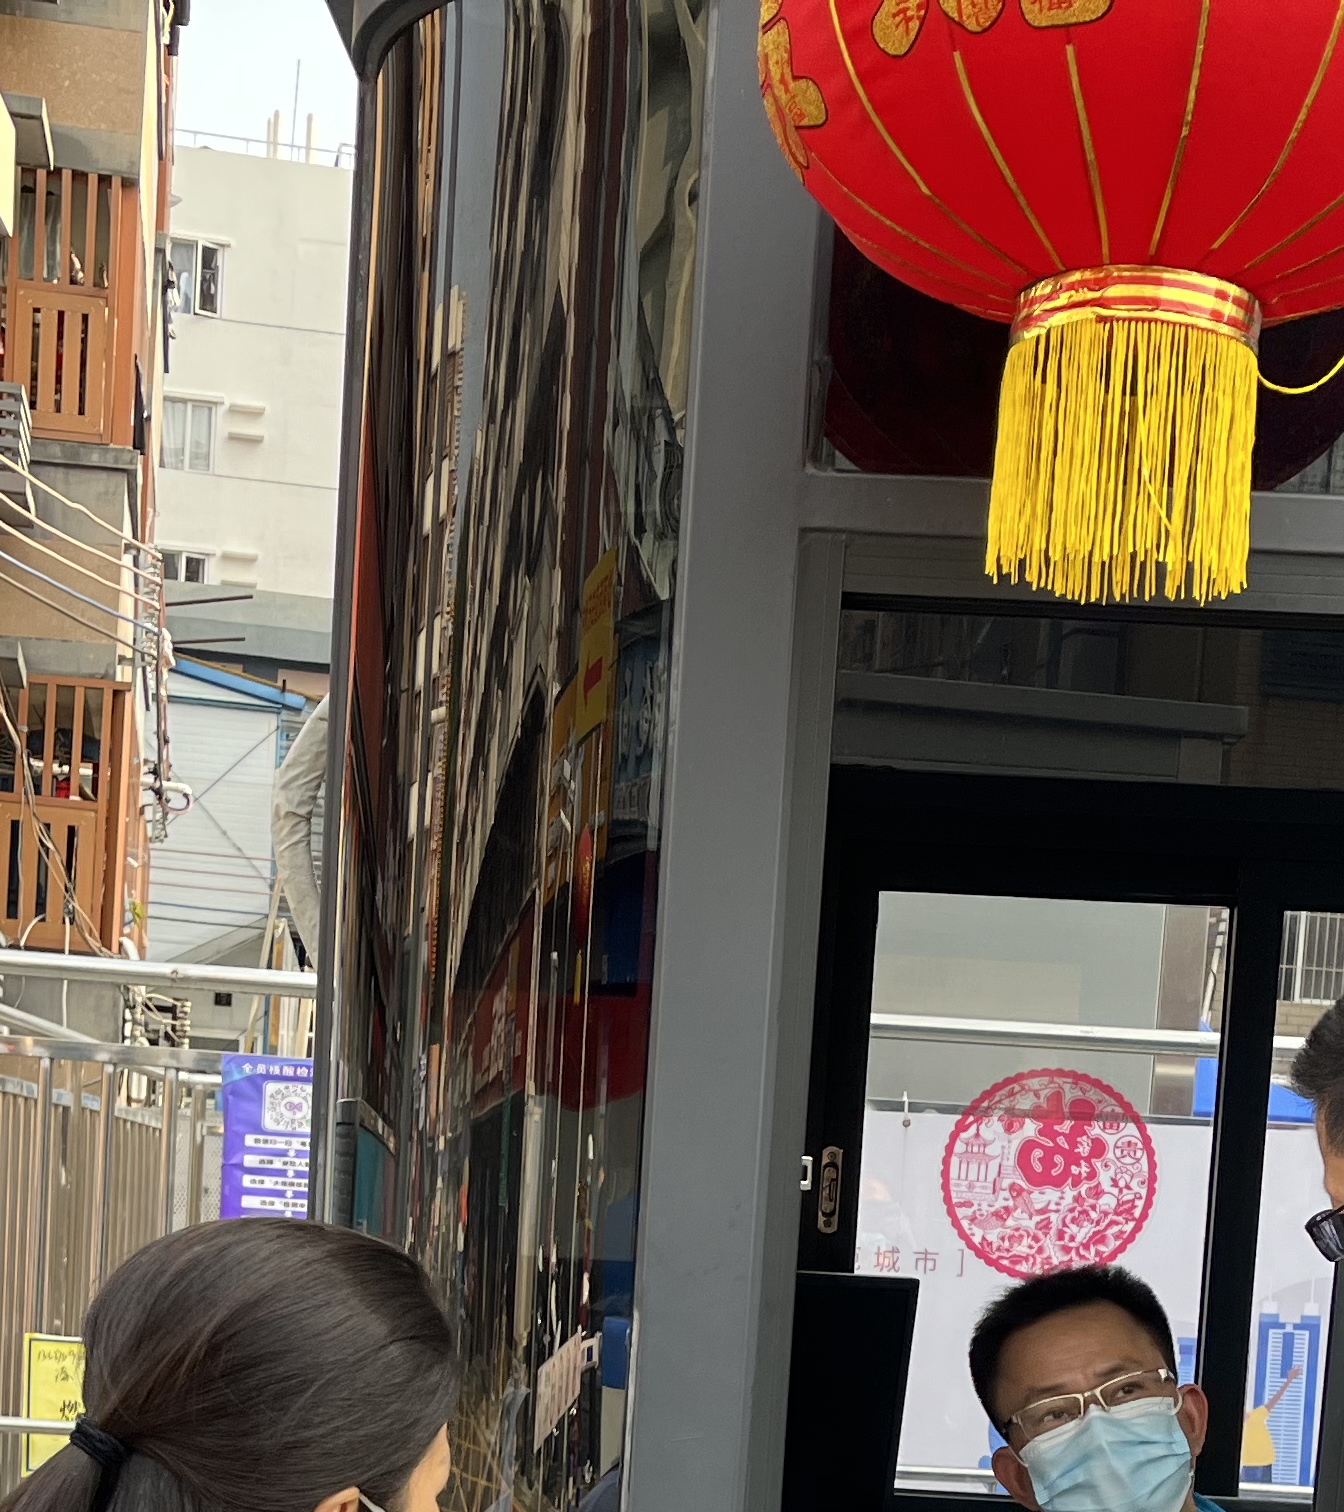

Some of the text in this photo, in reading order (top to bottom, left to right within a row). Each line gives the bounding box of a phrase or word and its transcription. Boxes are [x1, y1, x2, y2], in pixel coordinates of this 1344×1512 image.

[242, 1062, 313, 1078] 全员核酸检
[855, 1245, 965, 1278] 城市]
